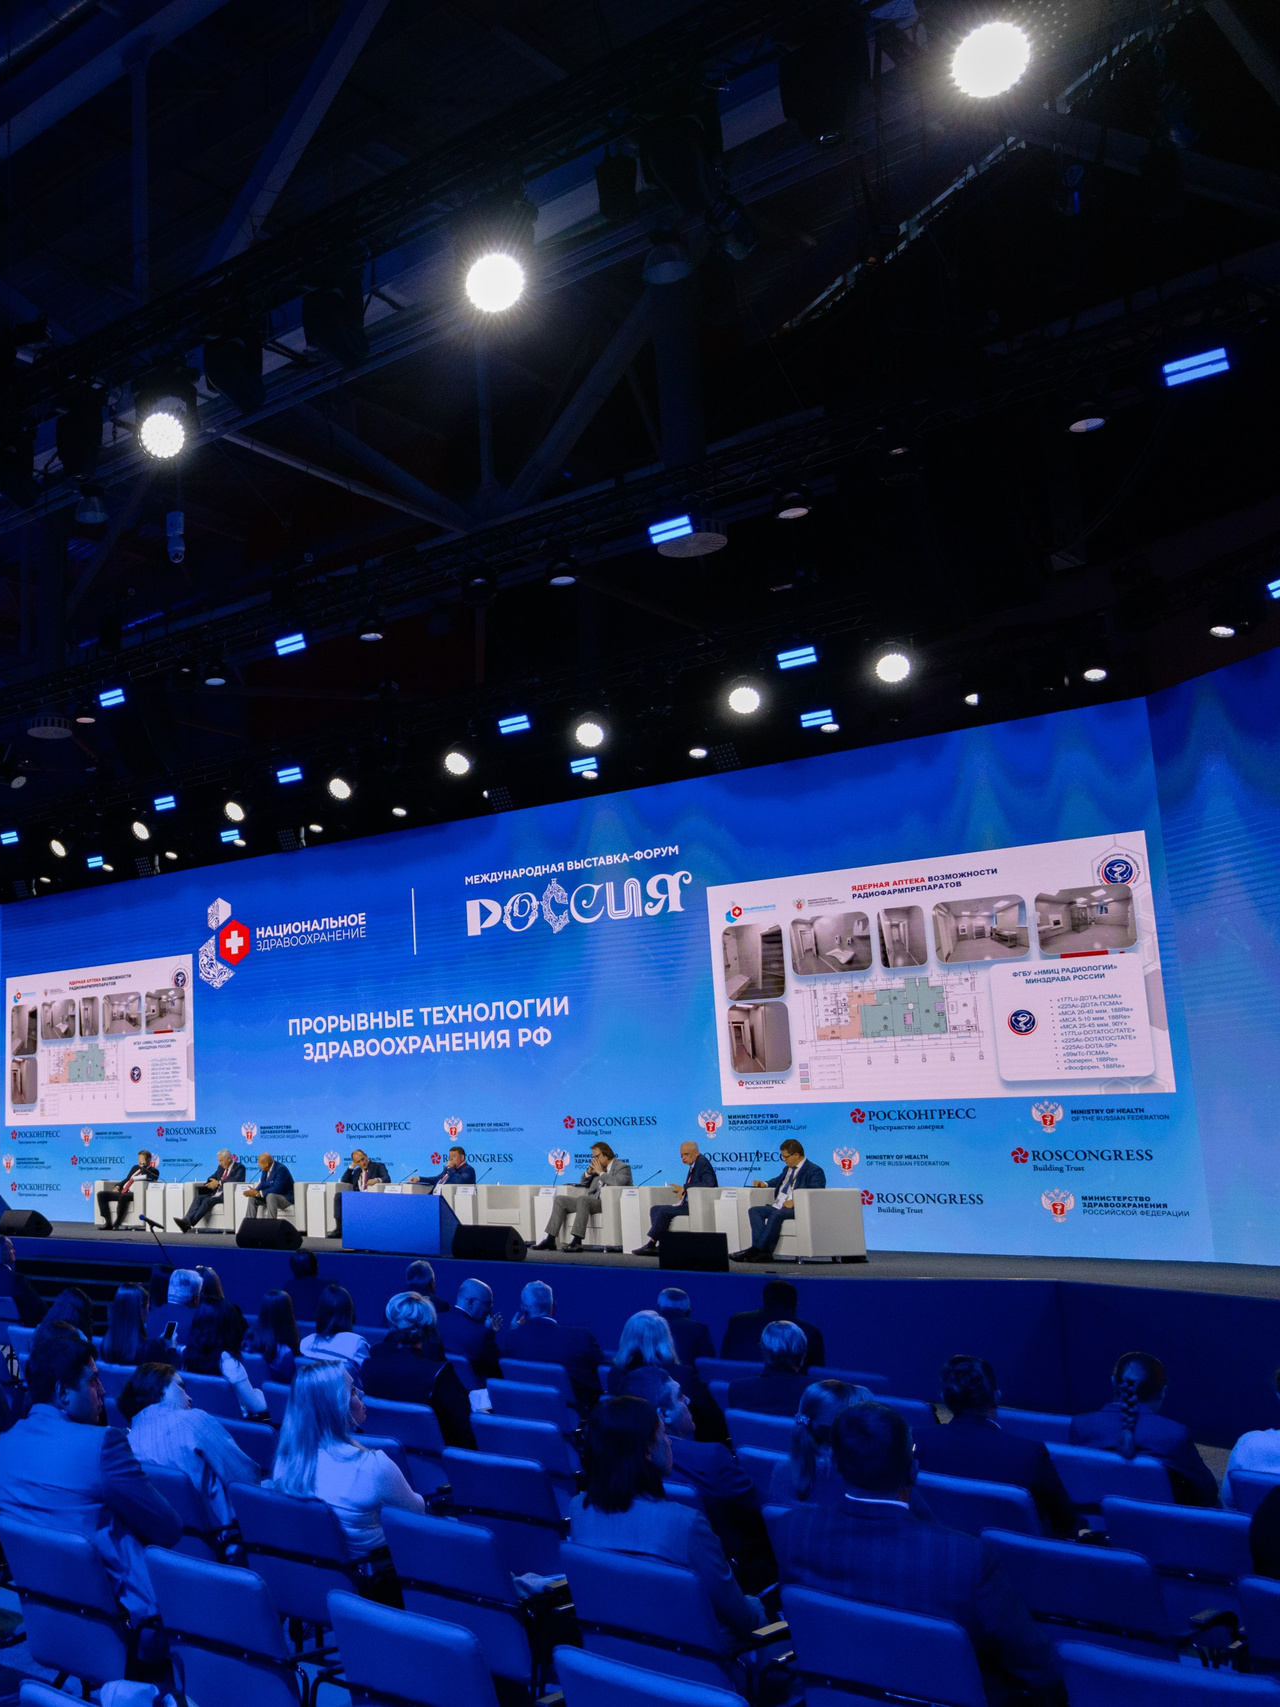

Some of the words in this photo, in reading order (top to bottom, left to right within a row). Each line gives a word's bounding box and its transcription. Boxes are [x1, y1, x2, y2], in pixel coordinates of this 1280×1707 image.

[465, 862, 565, 885] МЕЖДУНАРОДНАЯ
[567, 845, 679, 872] ВЫСТАВКА-ФОРУМ
[851, 881, 890, 892] ЯДЕРНАЯ
[892, 876, 926, 887] АПТЕКА
[928, 868, 998, 882] ВОЗМОЖНОСТИ
[852, 881, 962, 899] РАДИОФАРМПРЕПАРАТОВ
[466, 870, 693, 937] РОССИЯ
[256, 912, 367, 939] НАЦИОНАЛЬНОЕ
[256, 927, 367, 952] ЗДРАВООХРАНЕНИЕ
[1012, 970, 1032, 978] ФГБУ
[1061, 964, 1117, 974] РАДИОЛОГИИ»
[1025, 975, 1071, 985] МИНЗДРАВА
[1073, 973, 1106, 981] РОССИИ
[288, 1008, 414, 1036] ПРОРЫВНЫЕ
[419, 996, 570, 1026] ТЕХНОЛОГИИ
[303, 1029, 511, 1063] ЗДРАВООХРАНЕНИЯ
[518, 1026, 552, 1047] РФ
[868, 1108, 976, 1121] РОСКОНГРЕСС
[346, 1122, 411, 1131] РОСКОНГРЕСС
[577, 1116, 657, 1127] ROSCONGRESS
[165, 1127, 217, 1136] ROSCONGRESS
[869, 1124, 915, 1132] Пространство
[1032, 1149, 1153, 1161] ROSCONGRESS
[1033, 1165, 1064, 1173] Building
[18, 1183, 61, 1191] РОСКОНГРЕСС
[876, 1193, 984, 1205] ROSCONGRESS
[877, 1207, 905, 1215] Building
[1139, 1210, 1190, 1218] ФЕДЕРАЦИИ
